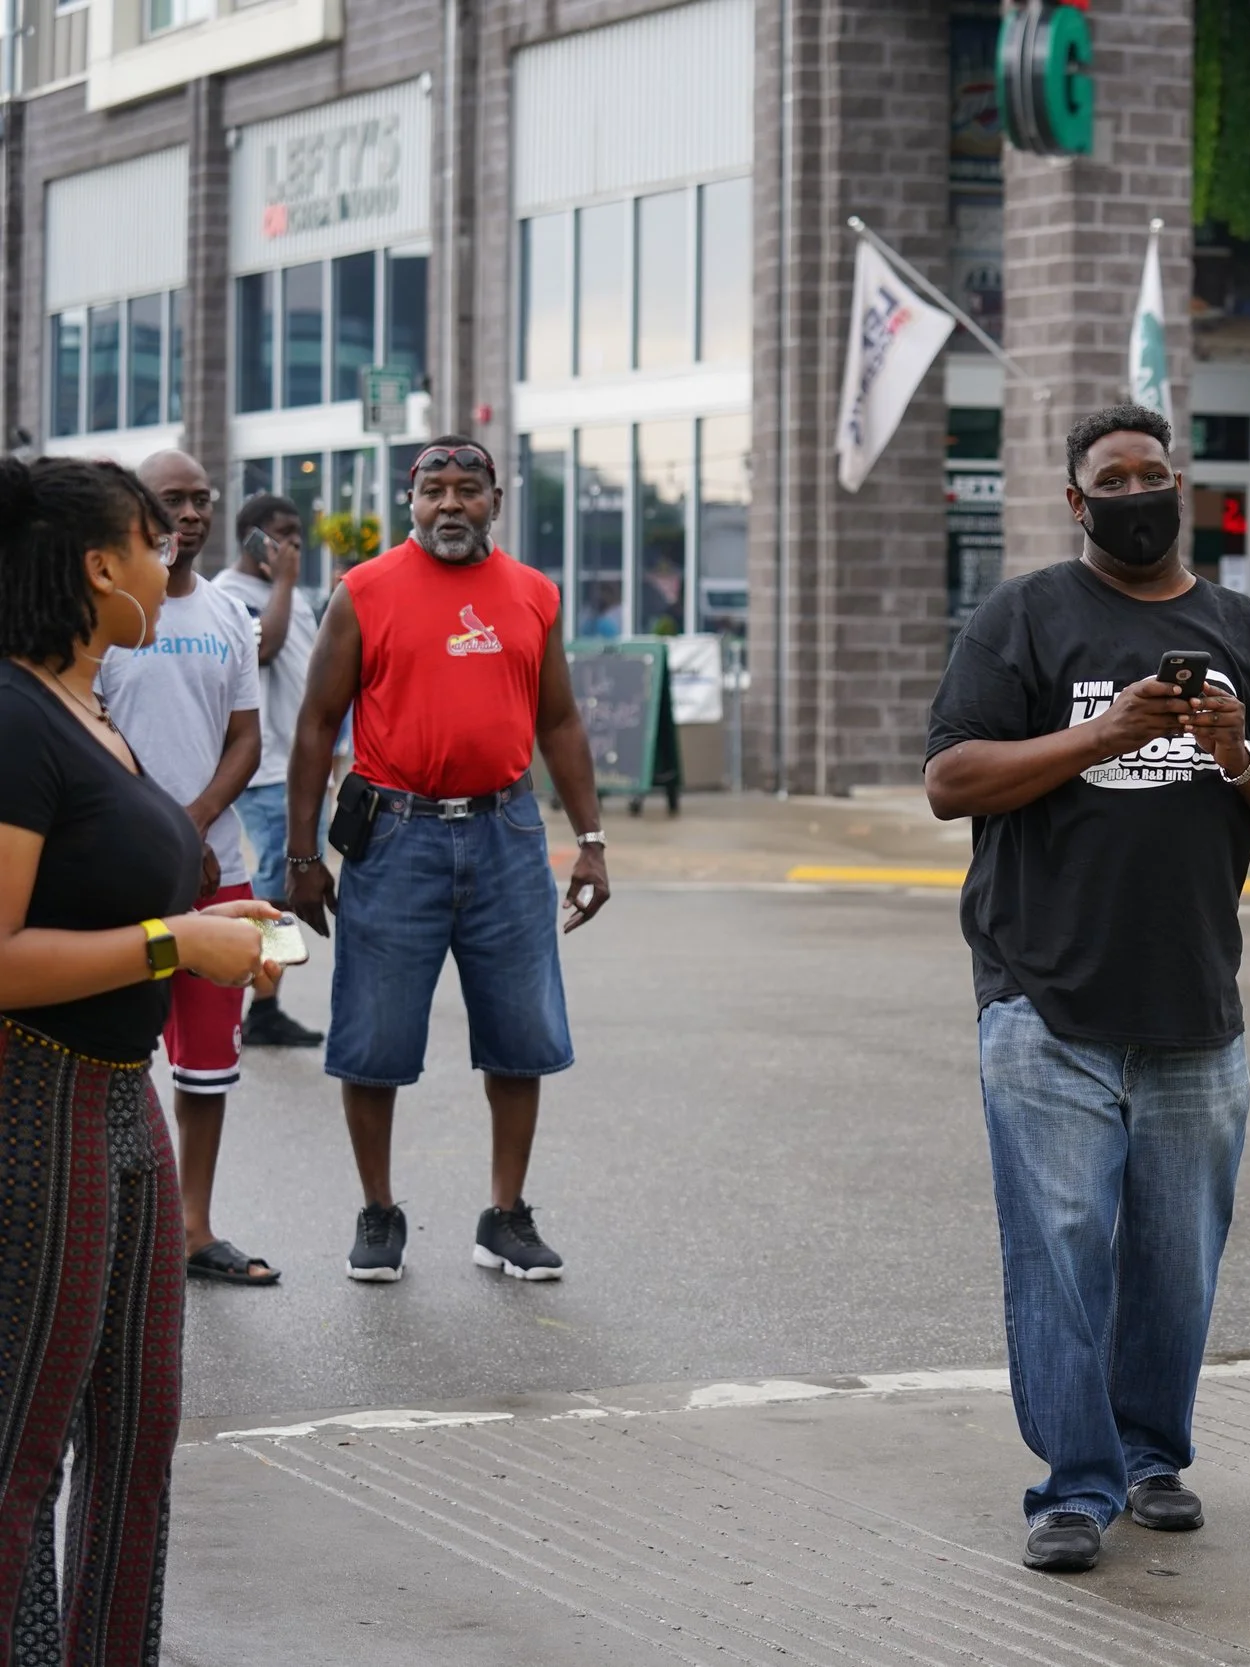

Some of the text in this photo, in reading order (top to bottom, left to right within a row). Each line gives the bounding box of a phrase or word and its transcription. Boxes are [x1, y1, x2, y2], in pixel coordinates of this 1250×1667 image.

[1073, 681, 1114, 698] KJMM
[1121, 736, 1214, 762] 05.
[1086, 769, 1192, 784] HIP-HOP & R&B HITS!
